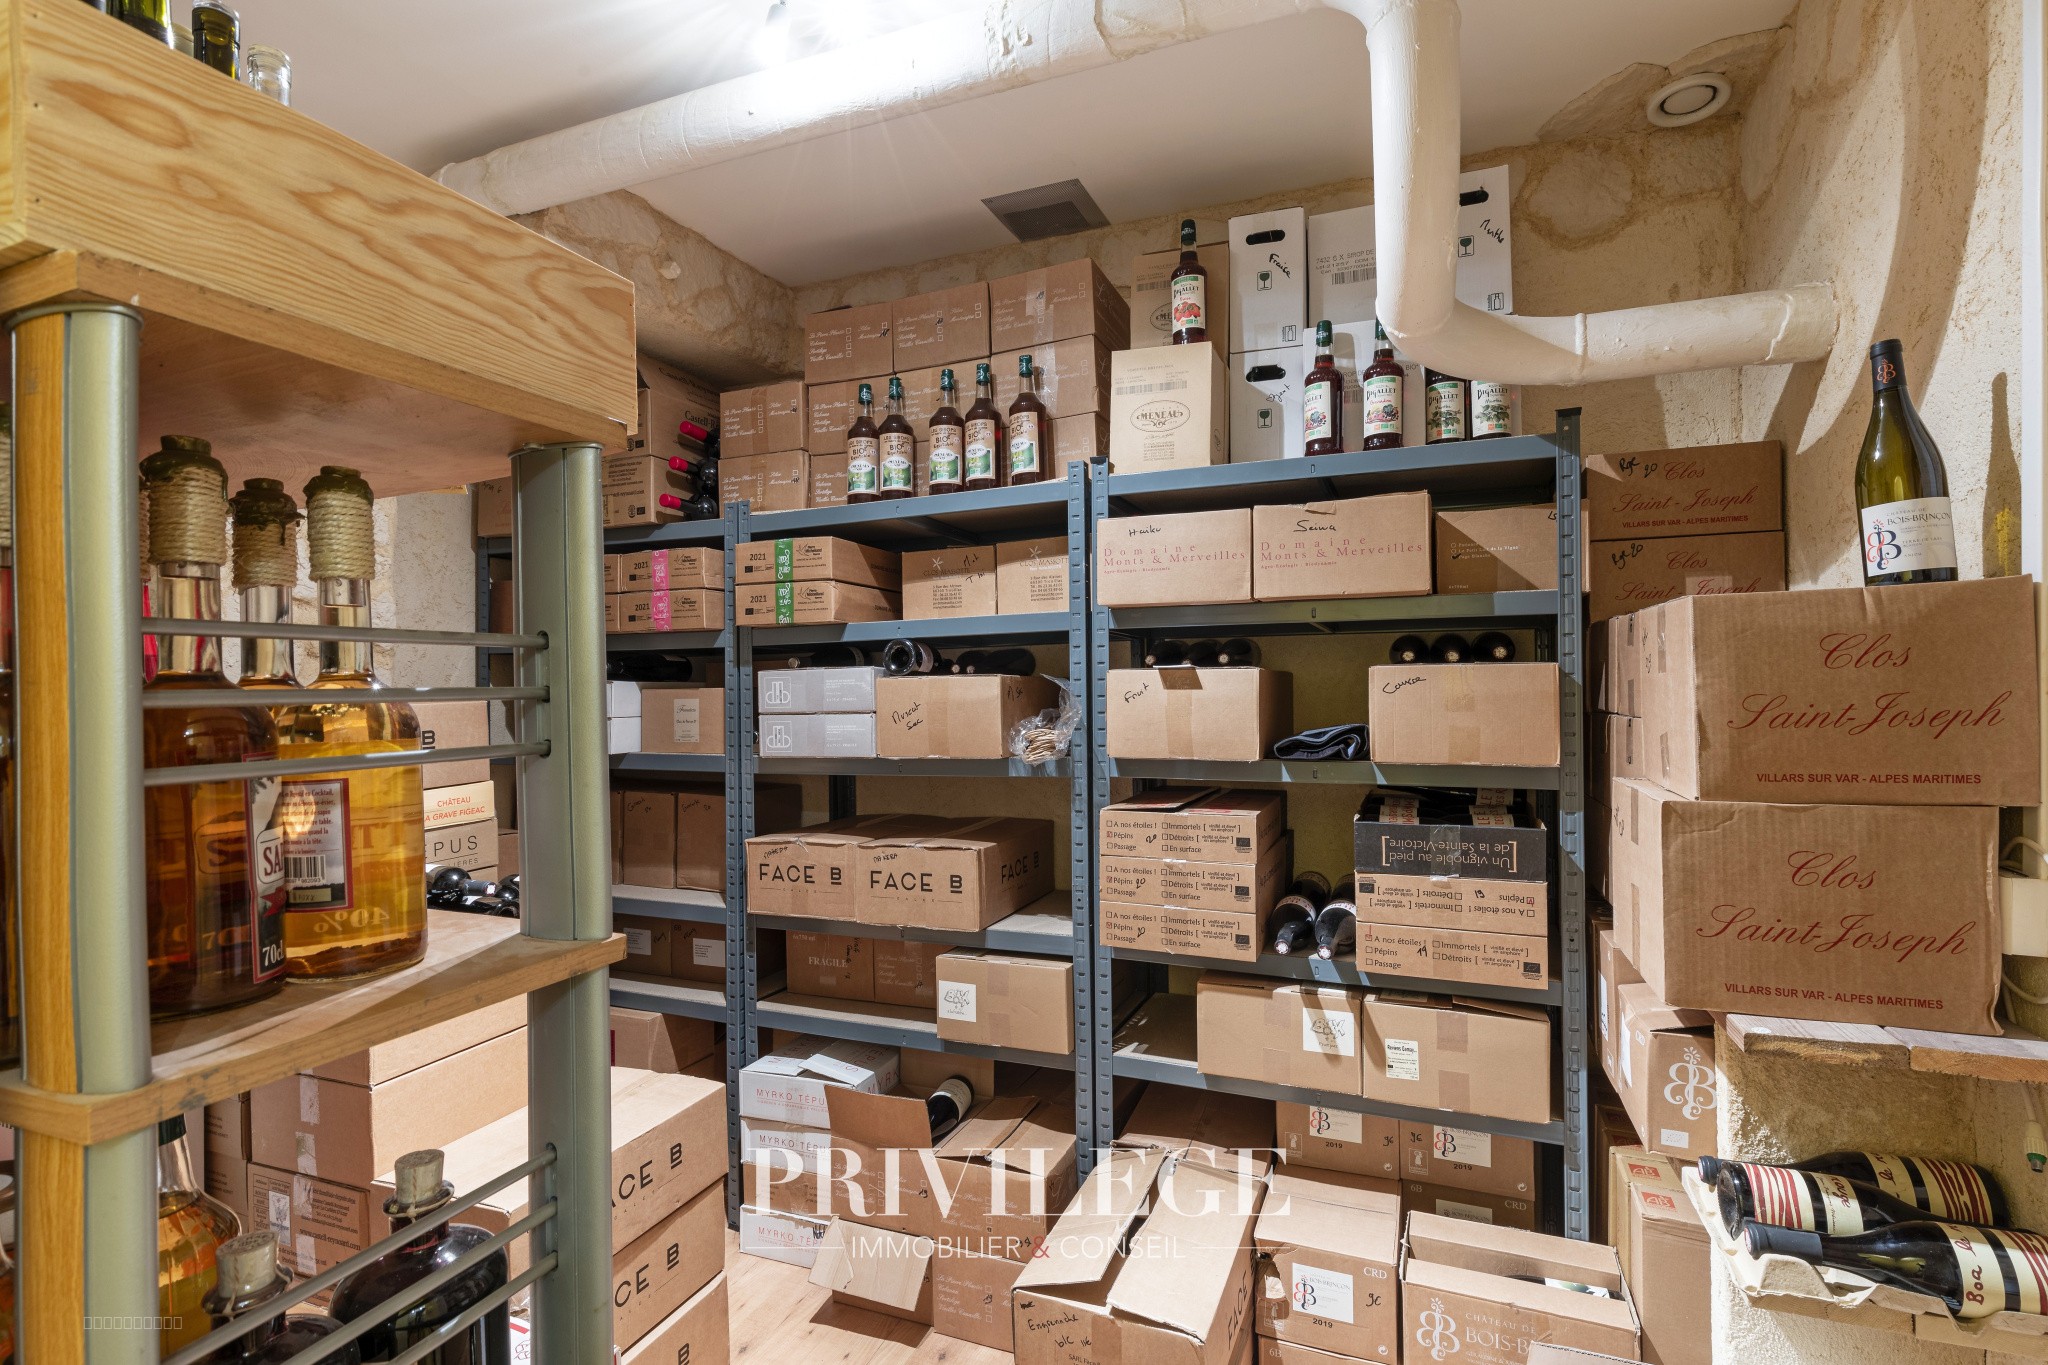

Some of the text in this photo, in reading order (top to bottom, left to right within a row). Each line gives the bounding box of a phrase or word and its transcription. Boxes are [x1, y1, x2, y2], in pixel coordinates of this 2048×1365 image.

[1477, 387, 1508, 400] BIGALLET
[1428, 393, 1458, 407] BIGALLET
[1663, 462, 1705, 480] Clos
[1710, 515, 1749, 524] MARITIMES
[1261, 537, 1366, 551] Domaine
[749, 552, 766, 561] 2021
[1104, 545, 1196, 557] Domaine
[1261, 543, 1423, 562] Monts & Merveilles
[1104, 551, 1246, 567] Monts & Merveilles
[1666, 551, 1709, 570] Clos
[633, 561, 648, 569] 2021
[750, 595, 767, 603] 2021
[635, 603, 650, 611] 2021
[1819, 633, 1912, 669] Clos
[1726, 690, 2013, 740] Saint-Joseph
[421, 729, 436, 749] B
[1756, 773, 1982, 785] VILLARS SUR VAR ALPES MARITIMES
[437, 796, 471, 807] CHÂTEAU
[433, 806, 485, 821] GRAVE FIGEAC
[1132, 821, 1153, 829] étoiles
[1168, 822, 1200, 831] Immortels
[1113, 832, 1134, 840] Pépins
[1168, 834, 1195, 842] Détroits
[425, 836, 478, 858] PUS
[1389, 839, 1511, 853] de la Sainte-Victoire
[1389, 851, 1511, 869] Un vignoble au pied
[759, 863, 842, 884] FACE B
[1000, 855, 1028, 884] FACE
[1168, 868, 1200, 877] Immortels
[1788, 850, 1878, 890] Clos
[870, 870, 963, 893] FACE B
[1113, 877, 1134, 885] Pépins
[1113, 888, 1137, 896] Passage
[1178, 893, 1201, 901] surface
[1422, 890, 1455, 900] Détroits
[1499, 894, 1526, 904] Pépins
[1414, 902, 1454, 912] Immortels
[1473, 905, 1500, 915] étoiles
[1132, 913, 1153, 921] étoiles
[1168, 915, 1200, 925] Immortels
[1113, 922, 1134, 931] Pépins
[1168, 927, 1194, 936] Détroits
[1113, 934, 1136, 943] Passage
[1696, 904, 1977, 963] Saint-Joseph
[1178, 939, 1201, 949] surface
[1397, 937, 1422, 946] étoiles
[1441, 941, 1481, 952] Immortels
[1374, 947, 1398, 957] Pépins
[808, 956, 848, 968] FRAGILE
[1441, 953, 1472, 963] Détroits
[1374, 960, 1402, 969] Passage
[1724, 983, 1944, 1010] VILLARS SUR VAR ALPES MARITIMES
[756, 1087, 828, 1106] MYRKO TÉPU
[759, 1134, 795, 1148] MYRKO
[1325, 1141, 1343, 1149] 2019
[1453, 1163, 1473, 1171] 2019
[611, 1142, 683, 1208] CE B
[1410, 1184, 1423, 1193] 6B
[1504, 1200, 1527, 1210] CRD
[758, 1226, 794, 1241] MYRKO
[614, 1242, 680, 1308] CE B
[1363, 1266, 1388, 1279] CRD
[1227, 1285, 1248, 1350] FACE
[1312, 1317, 1333, 1329] 2019
[1465, 1312, 1536, 1334] CHÂTEAU DE
[1465, 1326, 1530, 1355] BOIS-B
